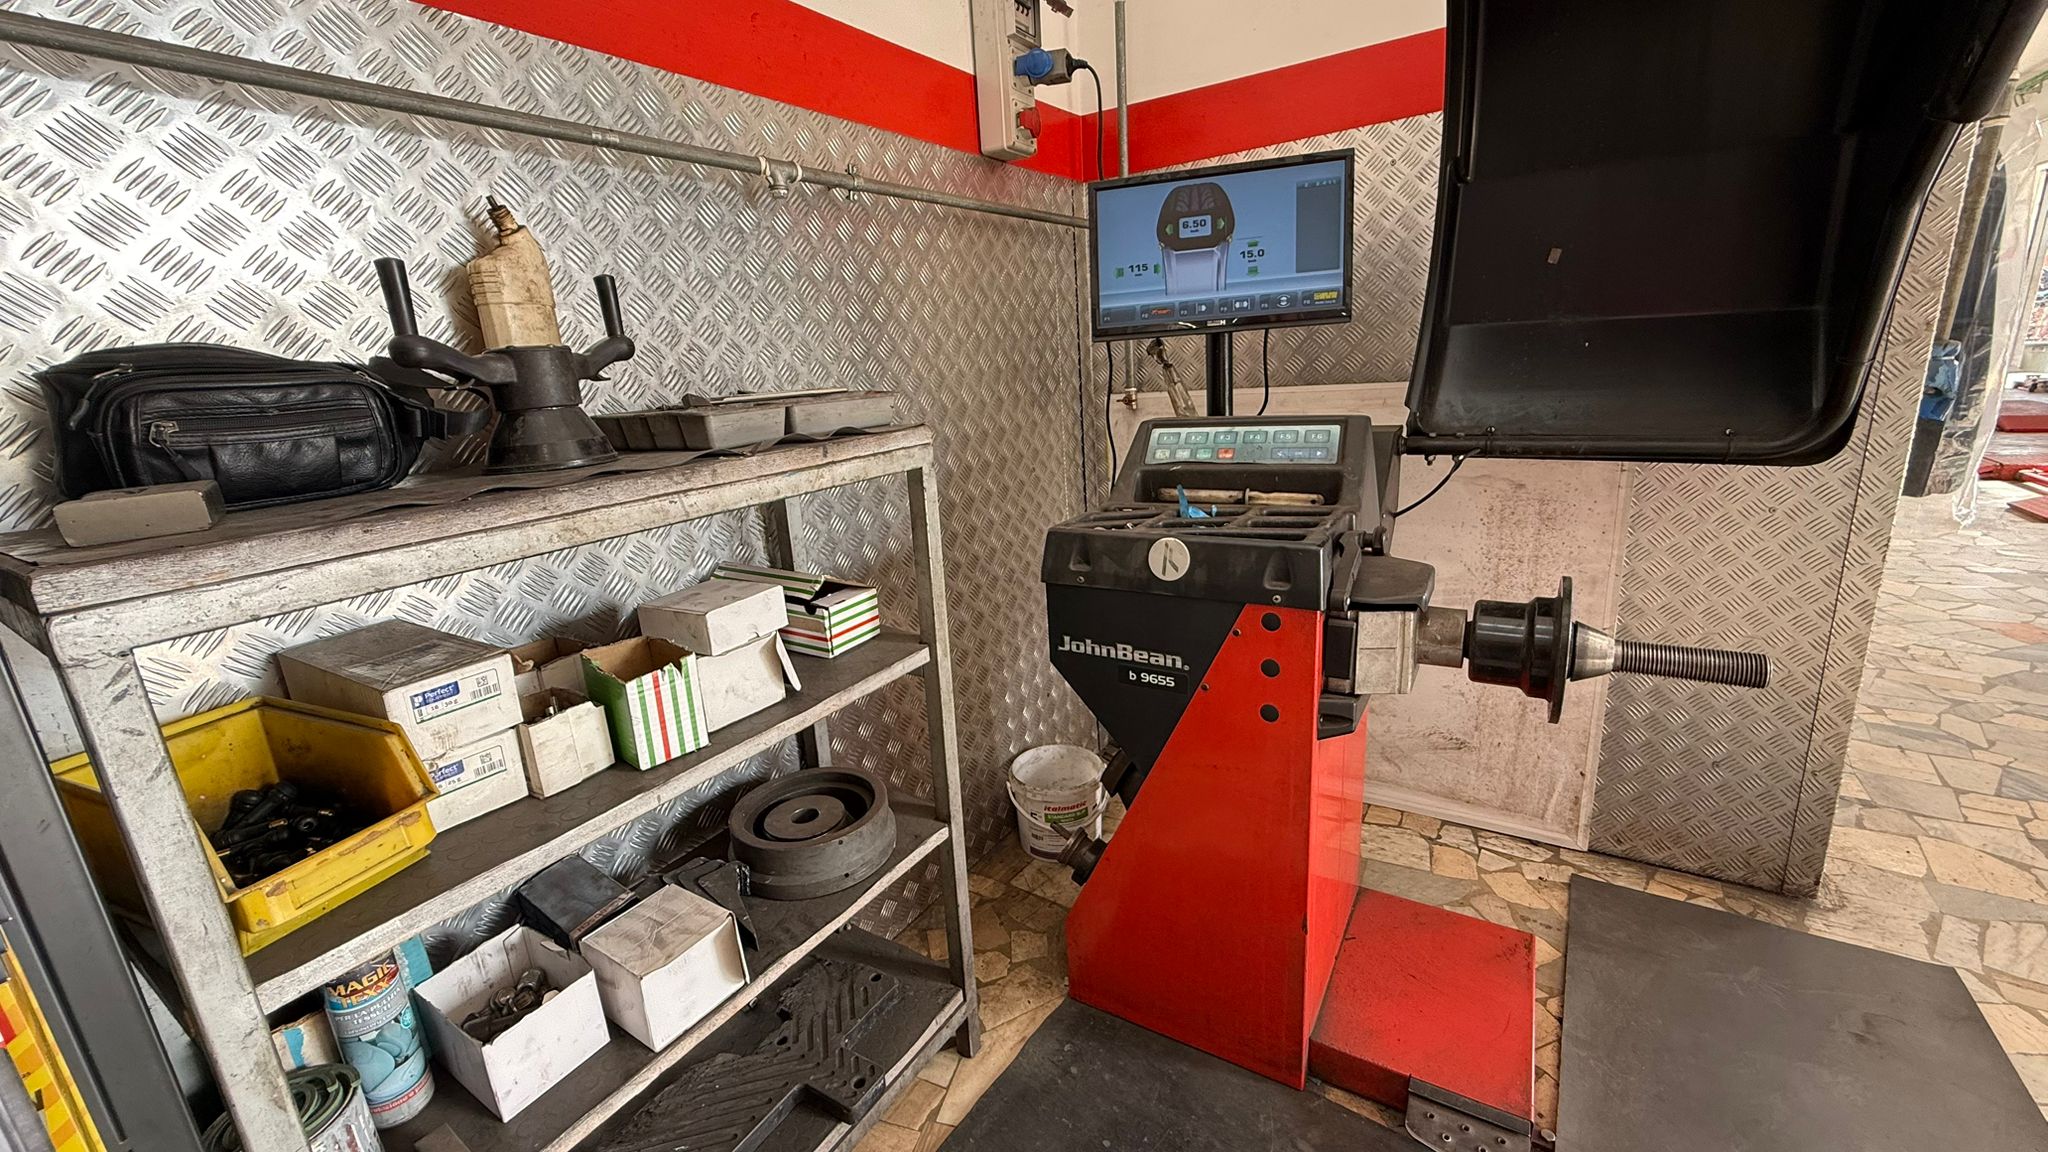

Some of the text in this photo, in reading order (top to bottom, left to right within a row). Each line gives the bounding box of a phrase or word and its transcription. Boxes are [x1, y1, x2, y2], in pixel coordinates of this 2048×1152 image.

[1182, 219, 1207, 230] 6.50
[1240, 249, 1265, 259] 15.0
[1128, 264, 1149, 273] 115
[1058, 635, 1182, 669] JohnBean
[1129, 670, 1175, 687] b 9655
[424, 684, 453, 699] Perfect
[340, 978, 390, 1008] TEXX
[354, 1009, 368, 1018] LA
